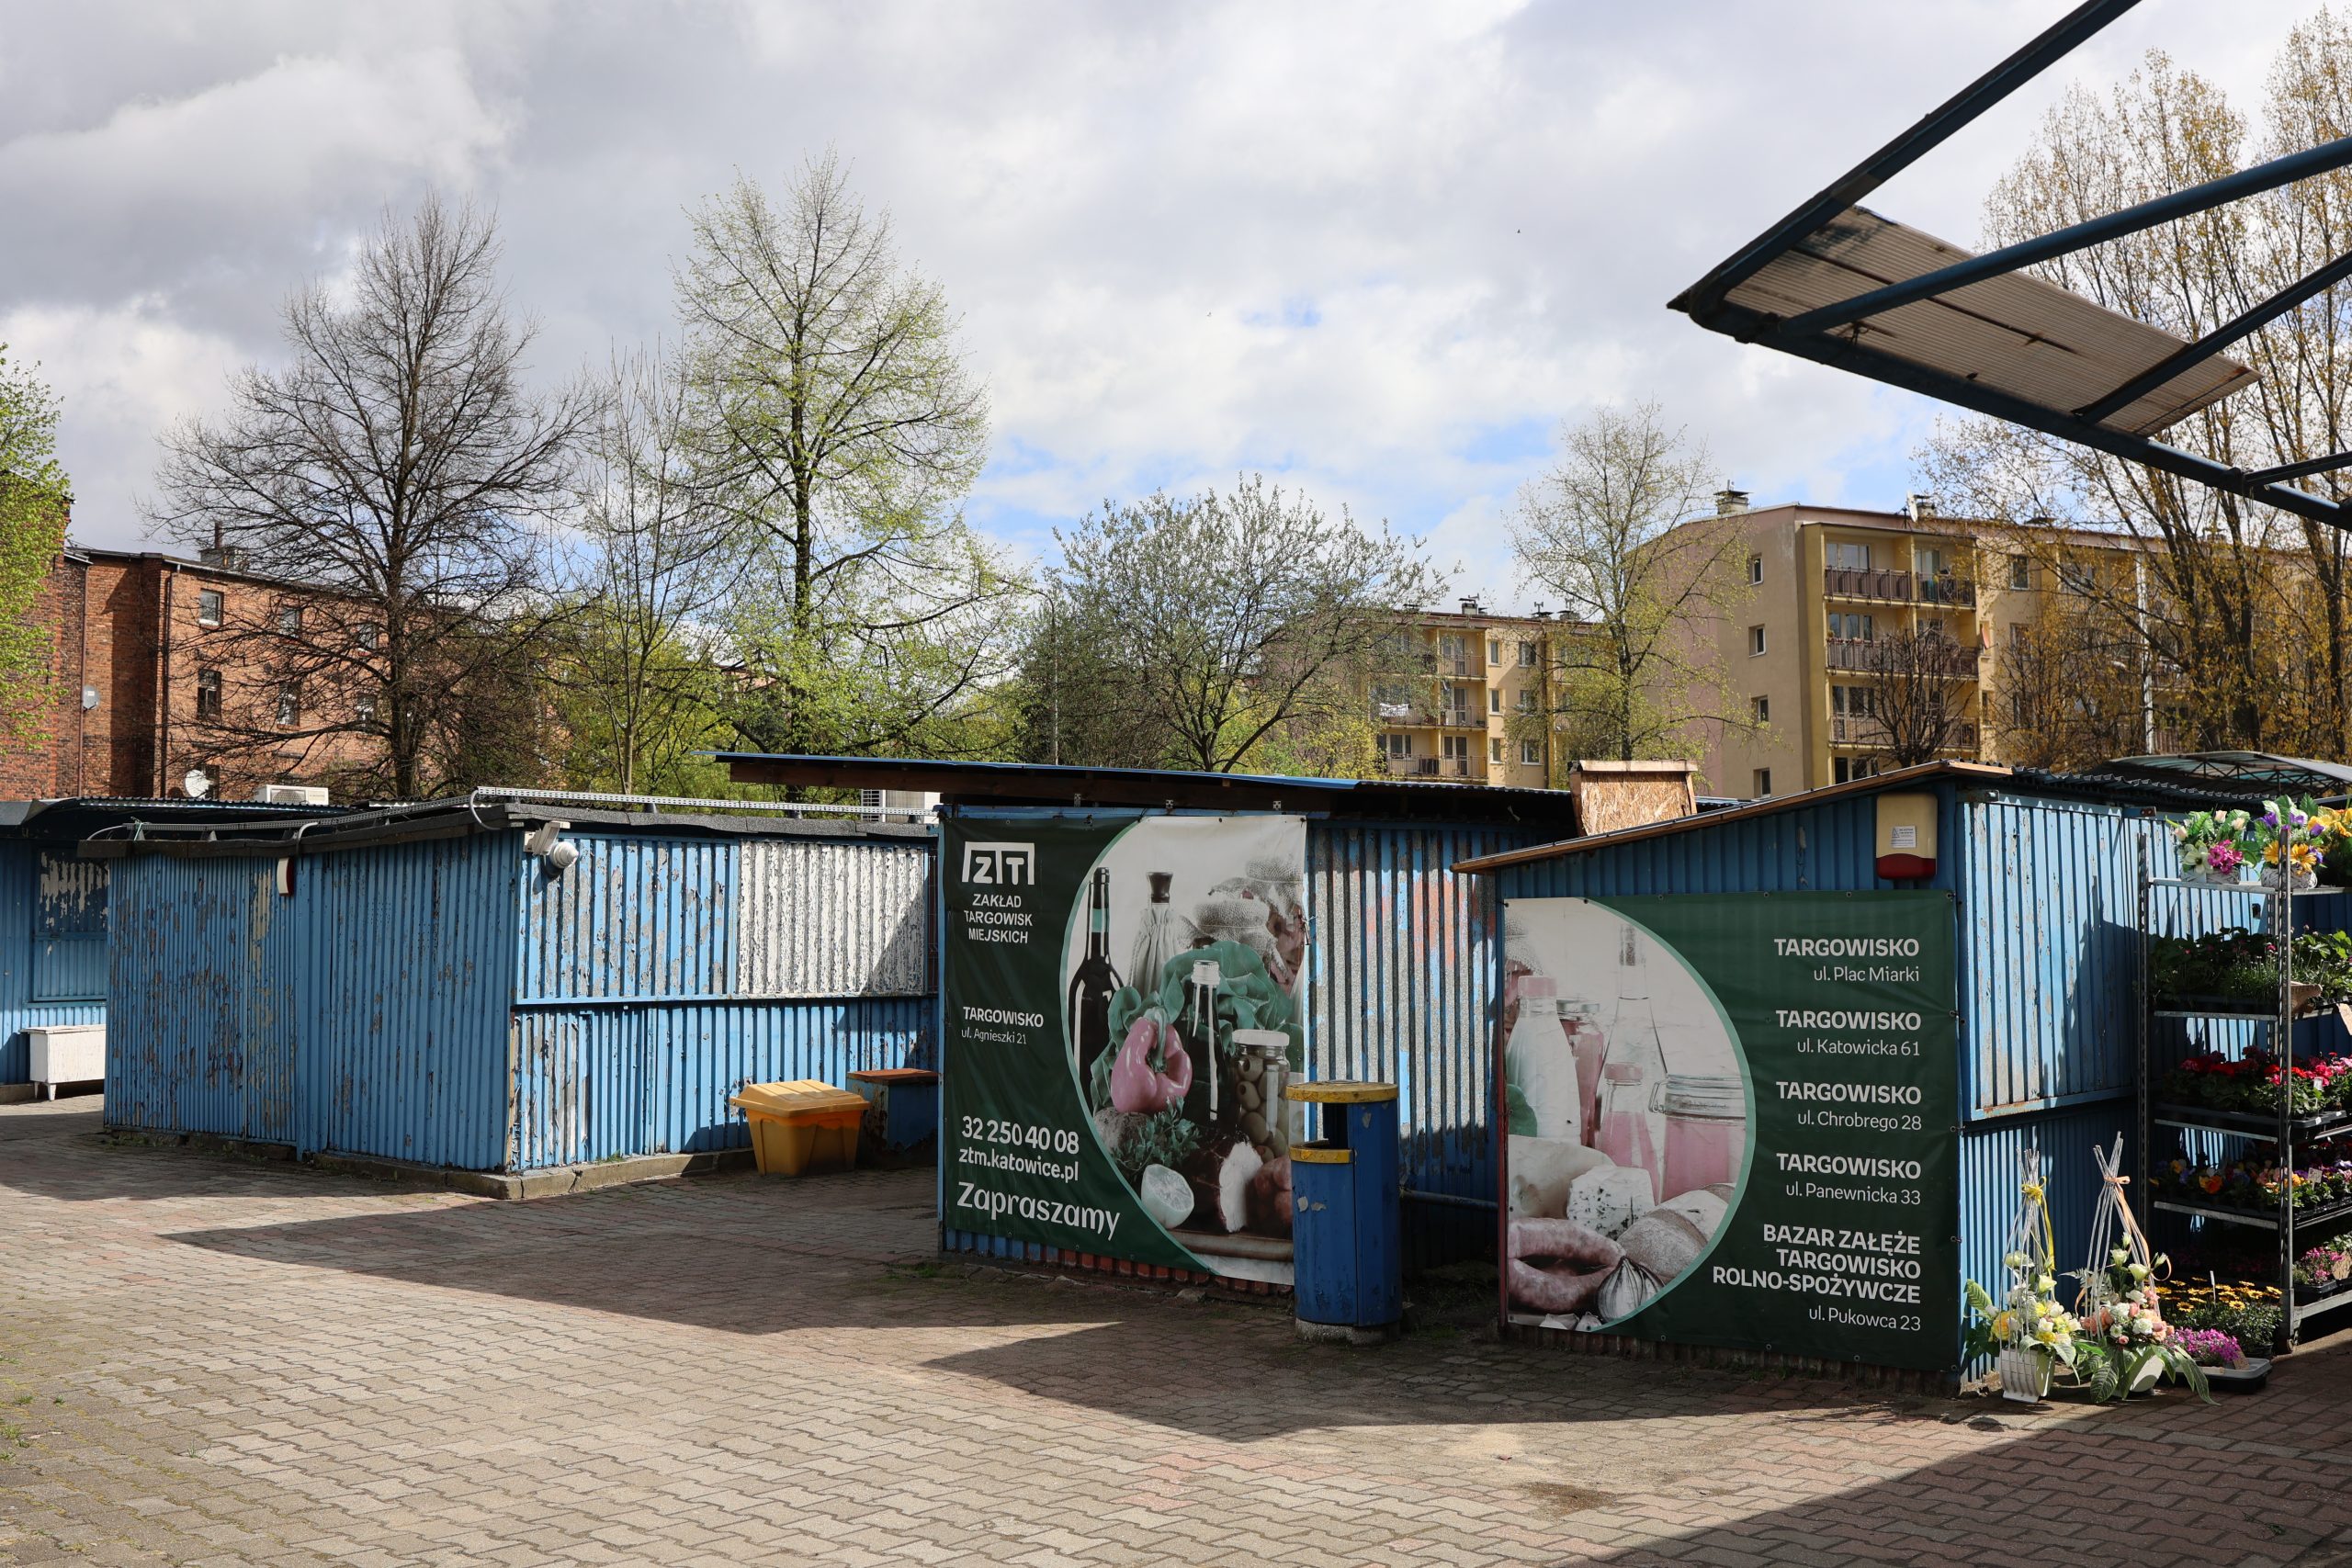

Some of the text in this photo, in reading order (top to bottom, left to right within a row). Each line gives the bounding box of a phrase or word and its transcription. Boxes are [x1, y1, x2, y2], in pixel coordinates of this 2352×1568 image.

[972, 894, 1022, 908] ZAKŁAD
[964, 910, 1033, 927] TARGOWISK
[968, 928, 1028, 944] MIEJSKICH
[1774, 938, 1919, 957] TARGOWISKO
[1814, 965, 1919, 982] ul. Plac Miarki
[963, 1006, 1045, 1029] TARGOWISKO
[1775, 1010, 1921, 1031] TARGOWISKO
[961, 1027, 1026, 1044] ul. Agnieszki 21
[1797, 1037, 1920, 1056] ul. Katowicka 61
[1775, 1081, 1922, 1105] TARGOWISKO
[1797, 1110, 1922, 1132] ul. Chrobrego 28
[962, 1115, 1080, 1155] 32 250 40 08
[958, 1146, 1080, 1184] ztm.katowice.pl
[1776, 1152, 1921, 1179] TARGOWISKO
[1786, 1181, 1921, 1205] ul. Panewnicka 33
[956, 1180, 1121, 1241] Zapraszamy
[1763, 1224, 1920, 1257] BAZAR ZAŁĘŻE
[1776, 1247, 1921, 1280] TARGOWISKO
[1713, 1265, 1921, 1304] ROLNO-SPOŻYWCZE
[1809, 1304, 1921, 1332] ul. Pukowca 23
